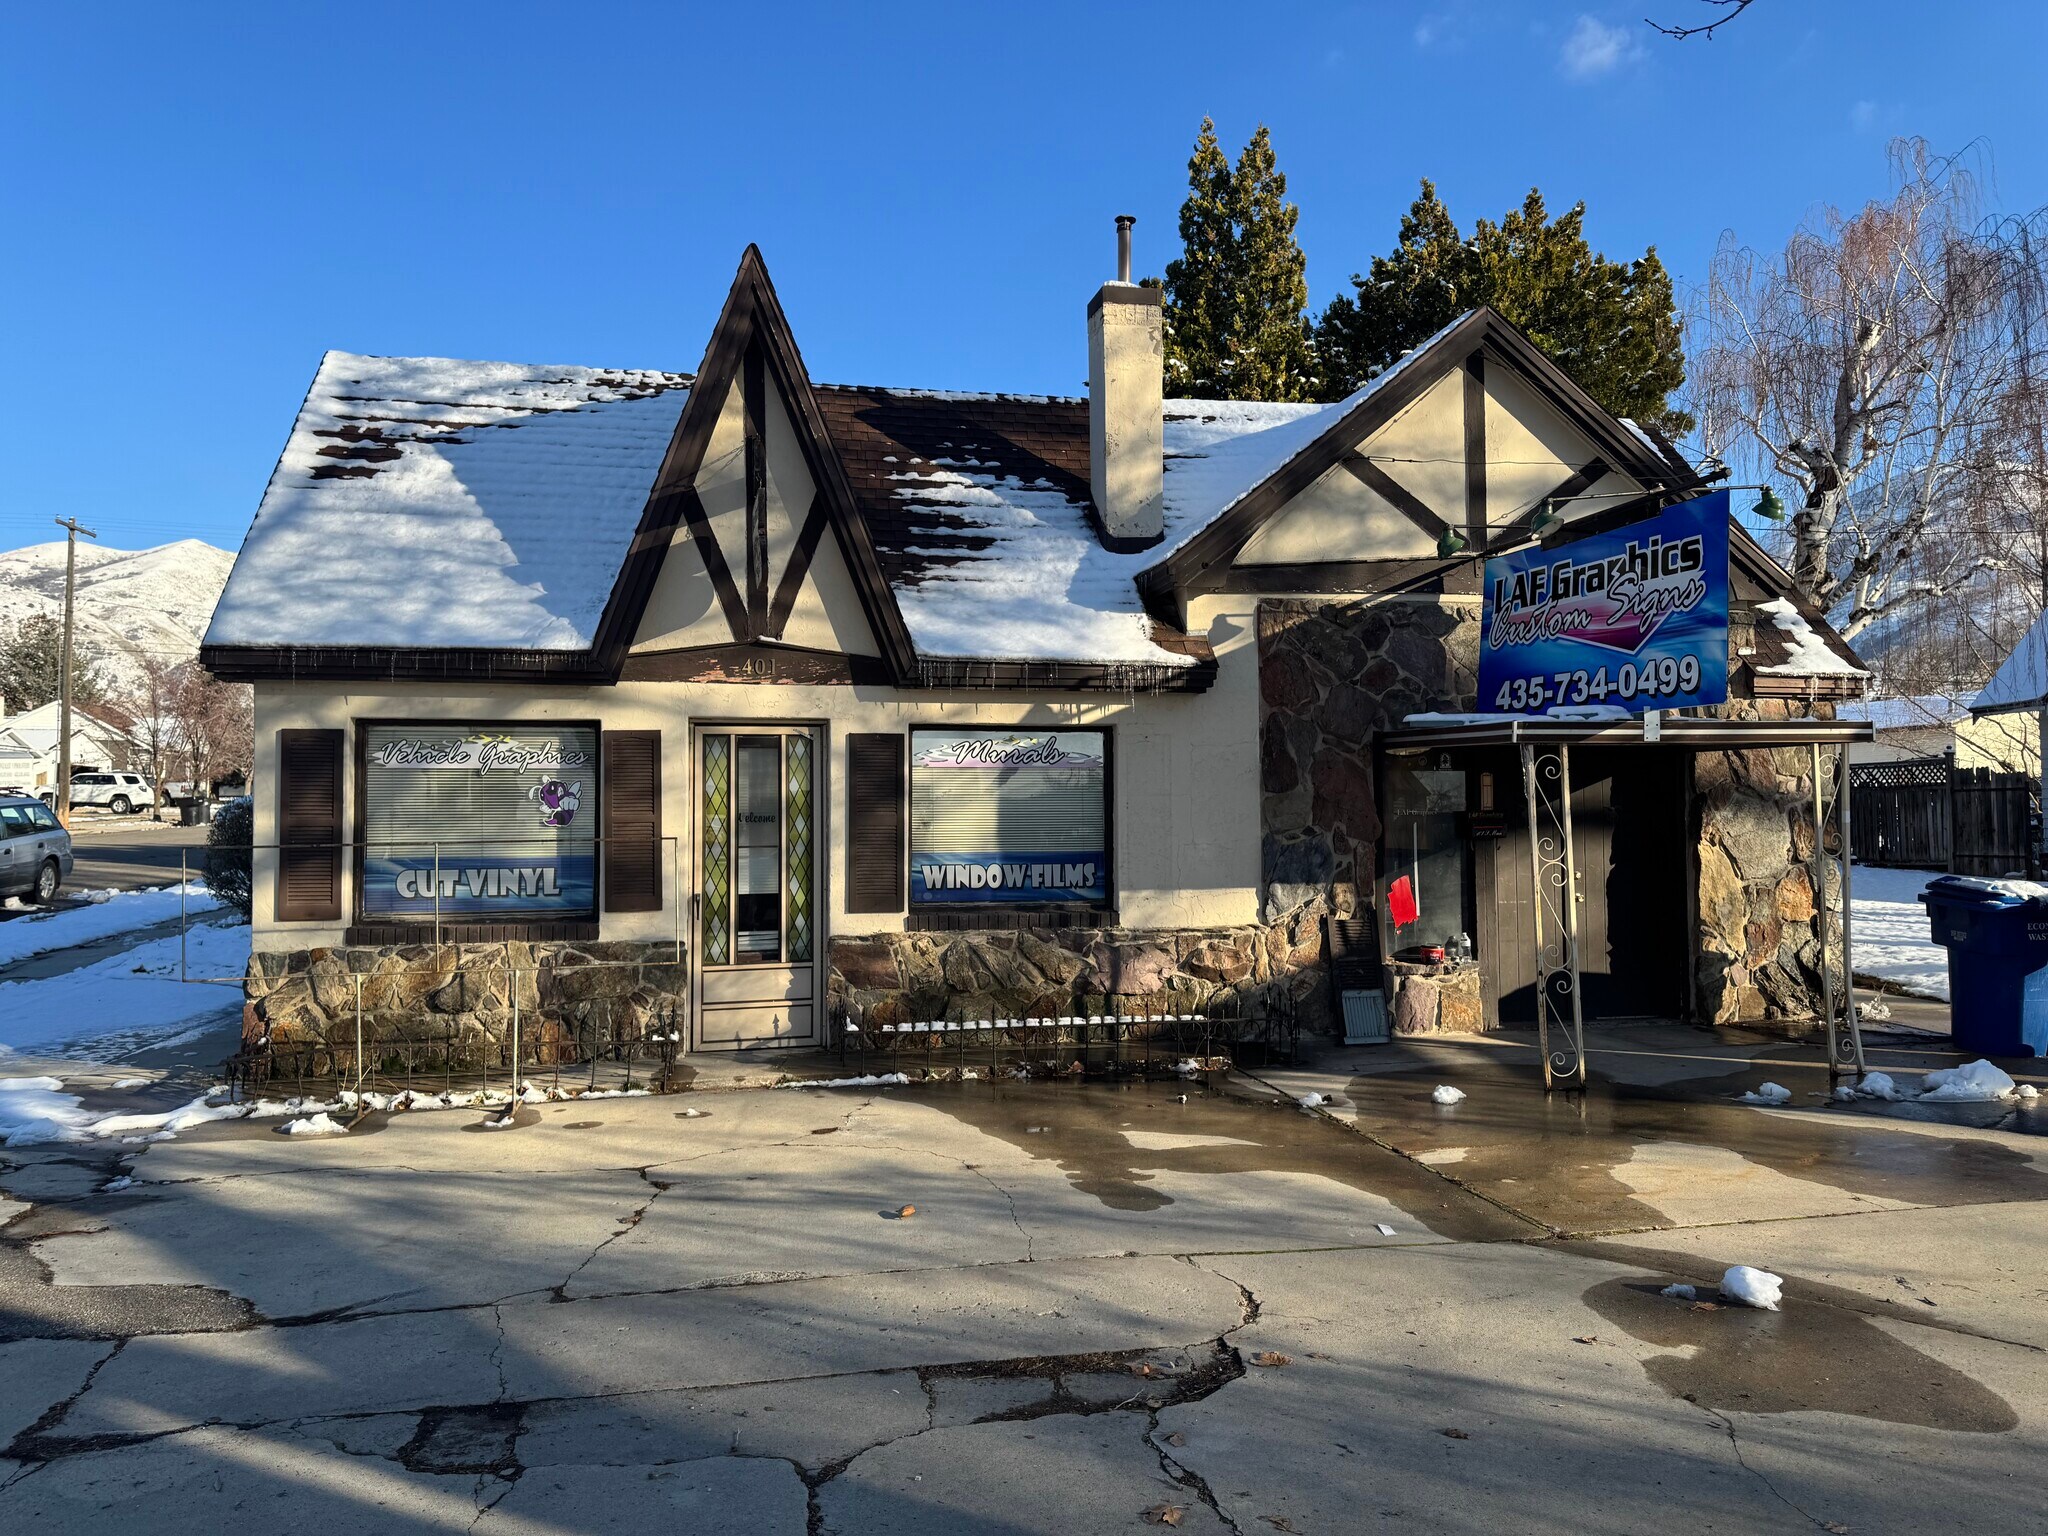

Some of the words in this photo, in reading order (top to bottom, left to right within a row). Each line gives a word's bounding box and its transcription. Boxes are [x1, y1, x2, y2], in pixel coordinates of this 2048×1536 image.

[1551, 535, 1702, 602] Graphics
[1490, 597, 1592, 648] Custom
[1606, 572, 1705, 635] Signs
[741, 658, 776, 675] 401
[1496, 656, 1700, 710] 435-734-0499
[382, 740, 471, 765] Vehicle
[478, 741, 589, 775] Graphics
[952, 735, 1066, 765] Murals
[396, 868, 459, 898] CUT
[465, 867, 562, 897] VINYL
[921, 864, 1027, 890] WINDOW
[1030, 862, 1096, 888] FILMS
